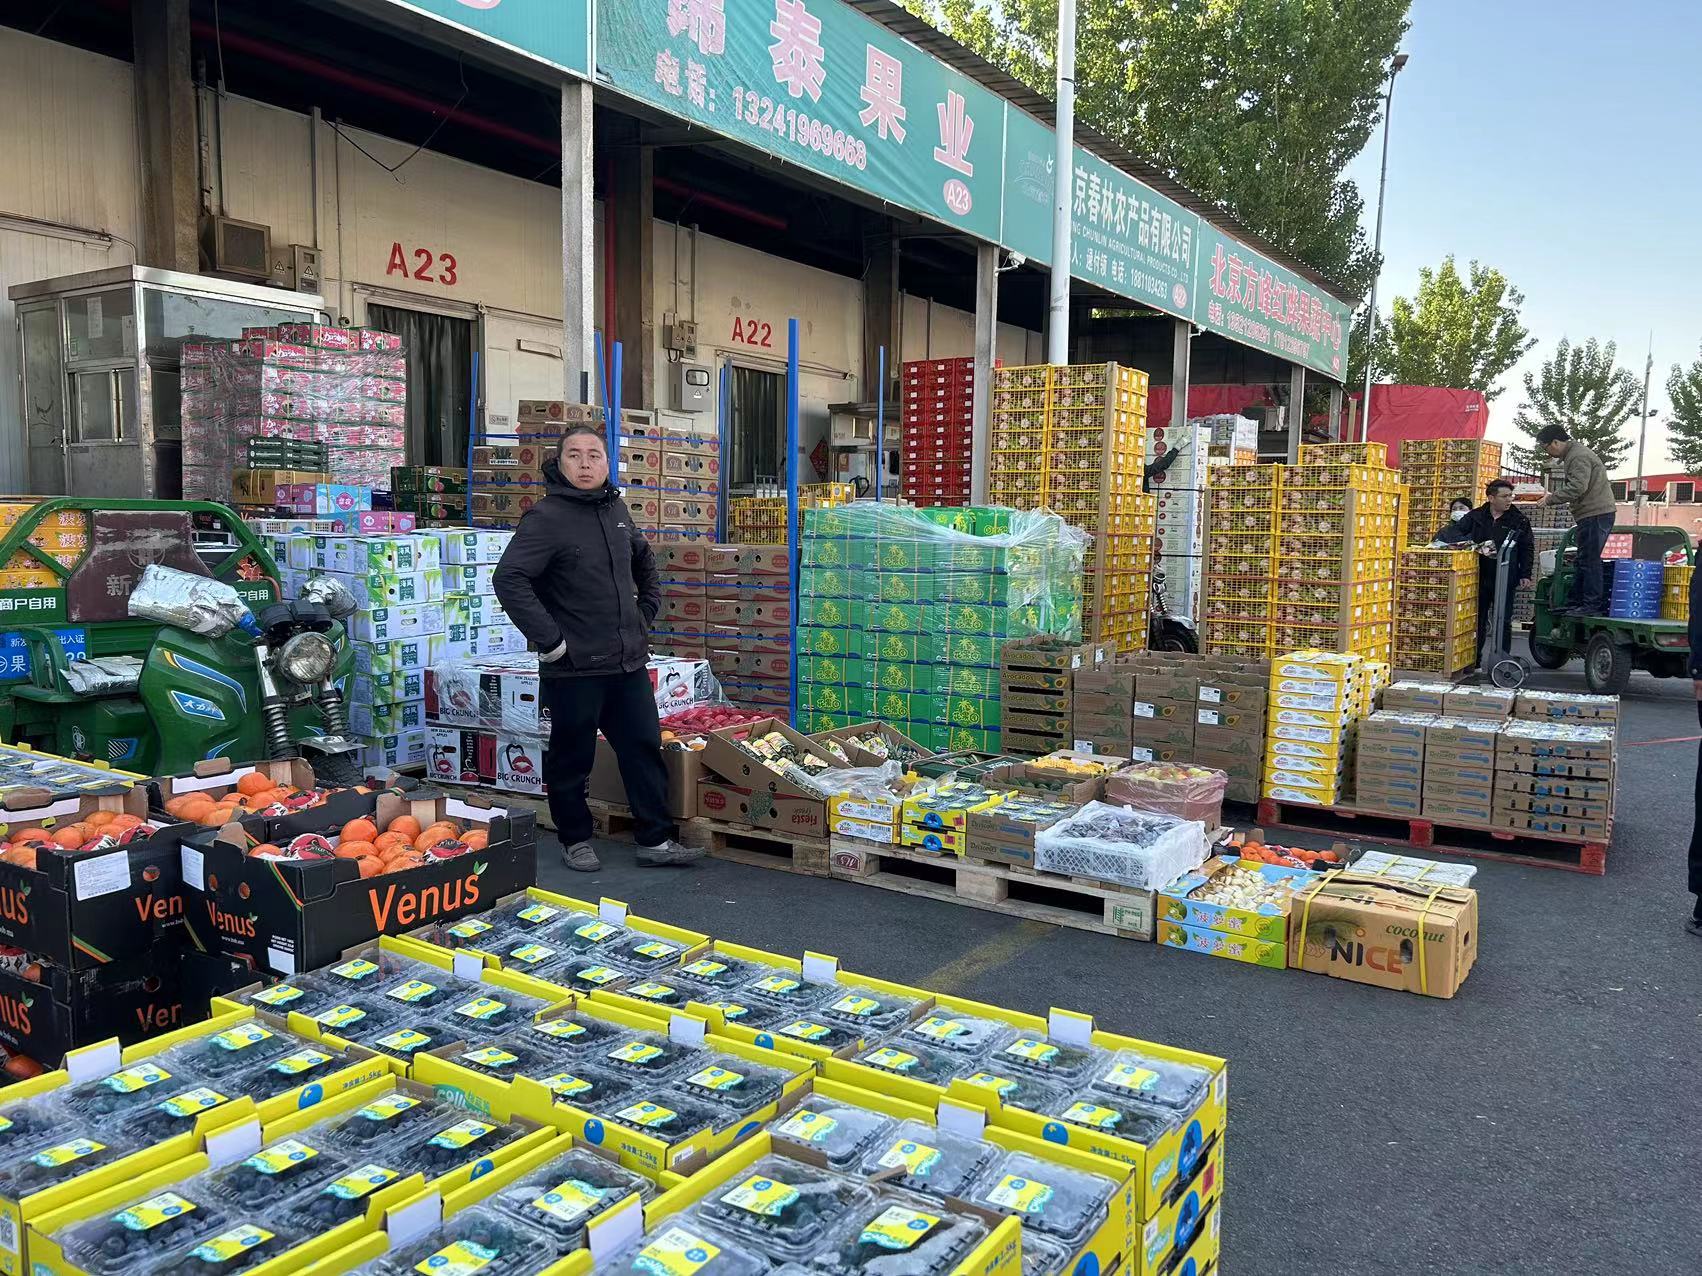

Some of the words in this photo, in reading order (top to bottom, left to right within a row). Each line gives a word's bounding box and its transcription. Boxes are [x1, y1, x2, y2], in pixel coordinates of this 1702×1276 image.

[733, 86, 867, 170] 13241969668
[946, 183, 970, 211] A23
[386, 242, 458, 286] A23
[731, 317, 772, 348] A22
[1002, 672, 1034, 680] Avocados
[440, 708, 451, 716] BIG
[498, 773, 509, 781] BIG
[511, 773, 542, 785] CRUNCH
[791, 814, 818, 827] Fiesta
[369, 874, 480, 932] Venus
[206, 900, 256, 937] Venus
[1386, 923, 1446, 944] coconut
